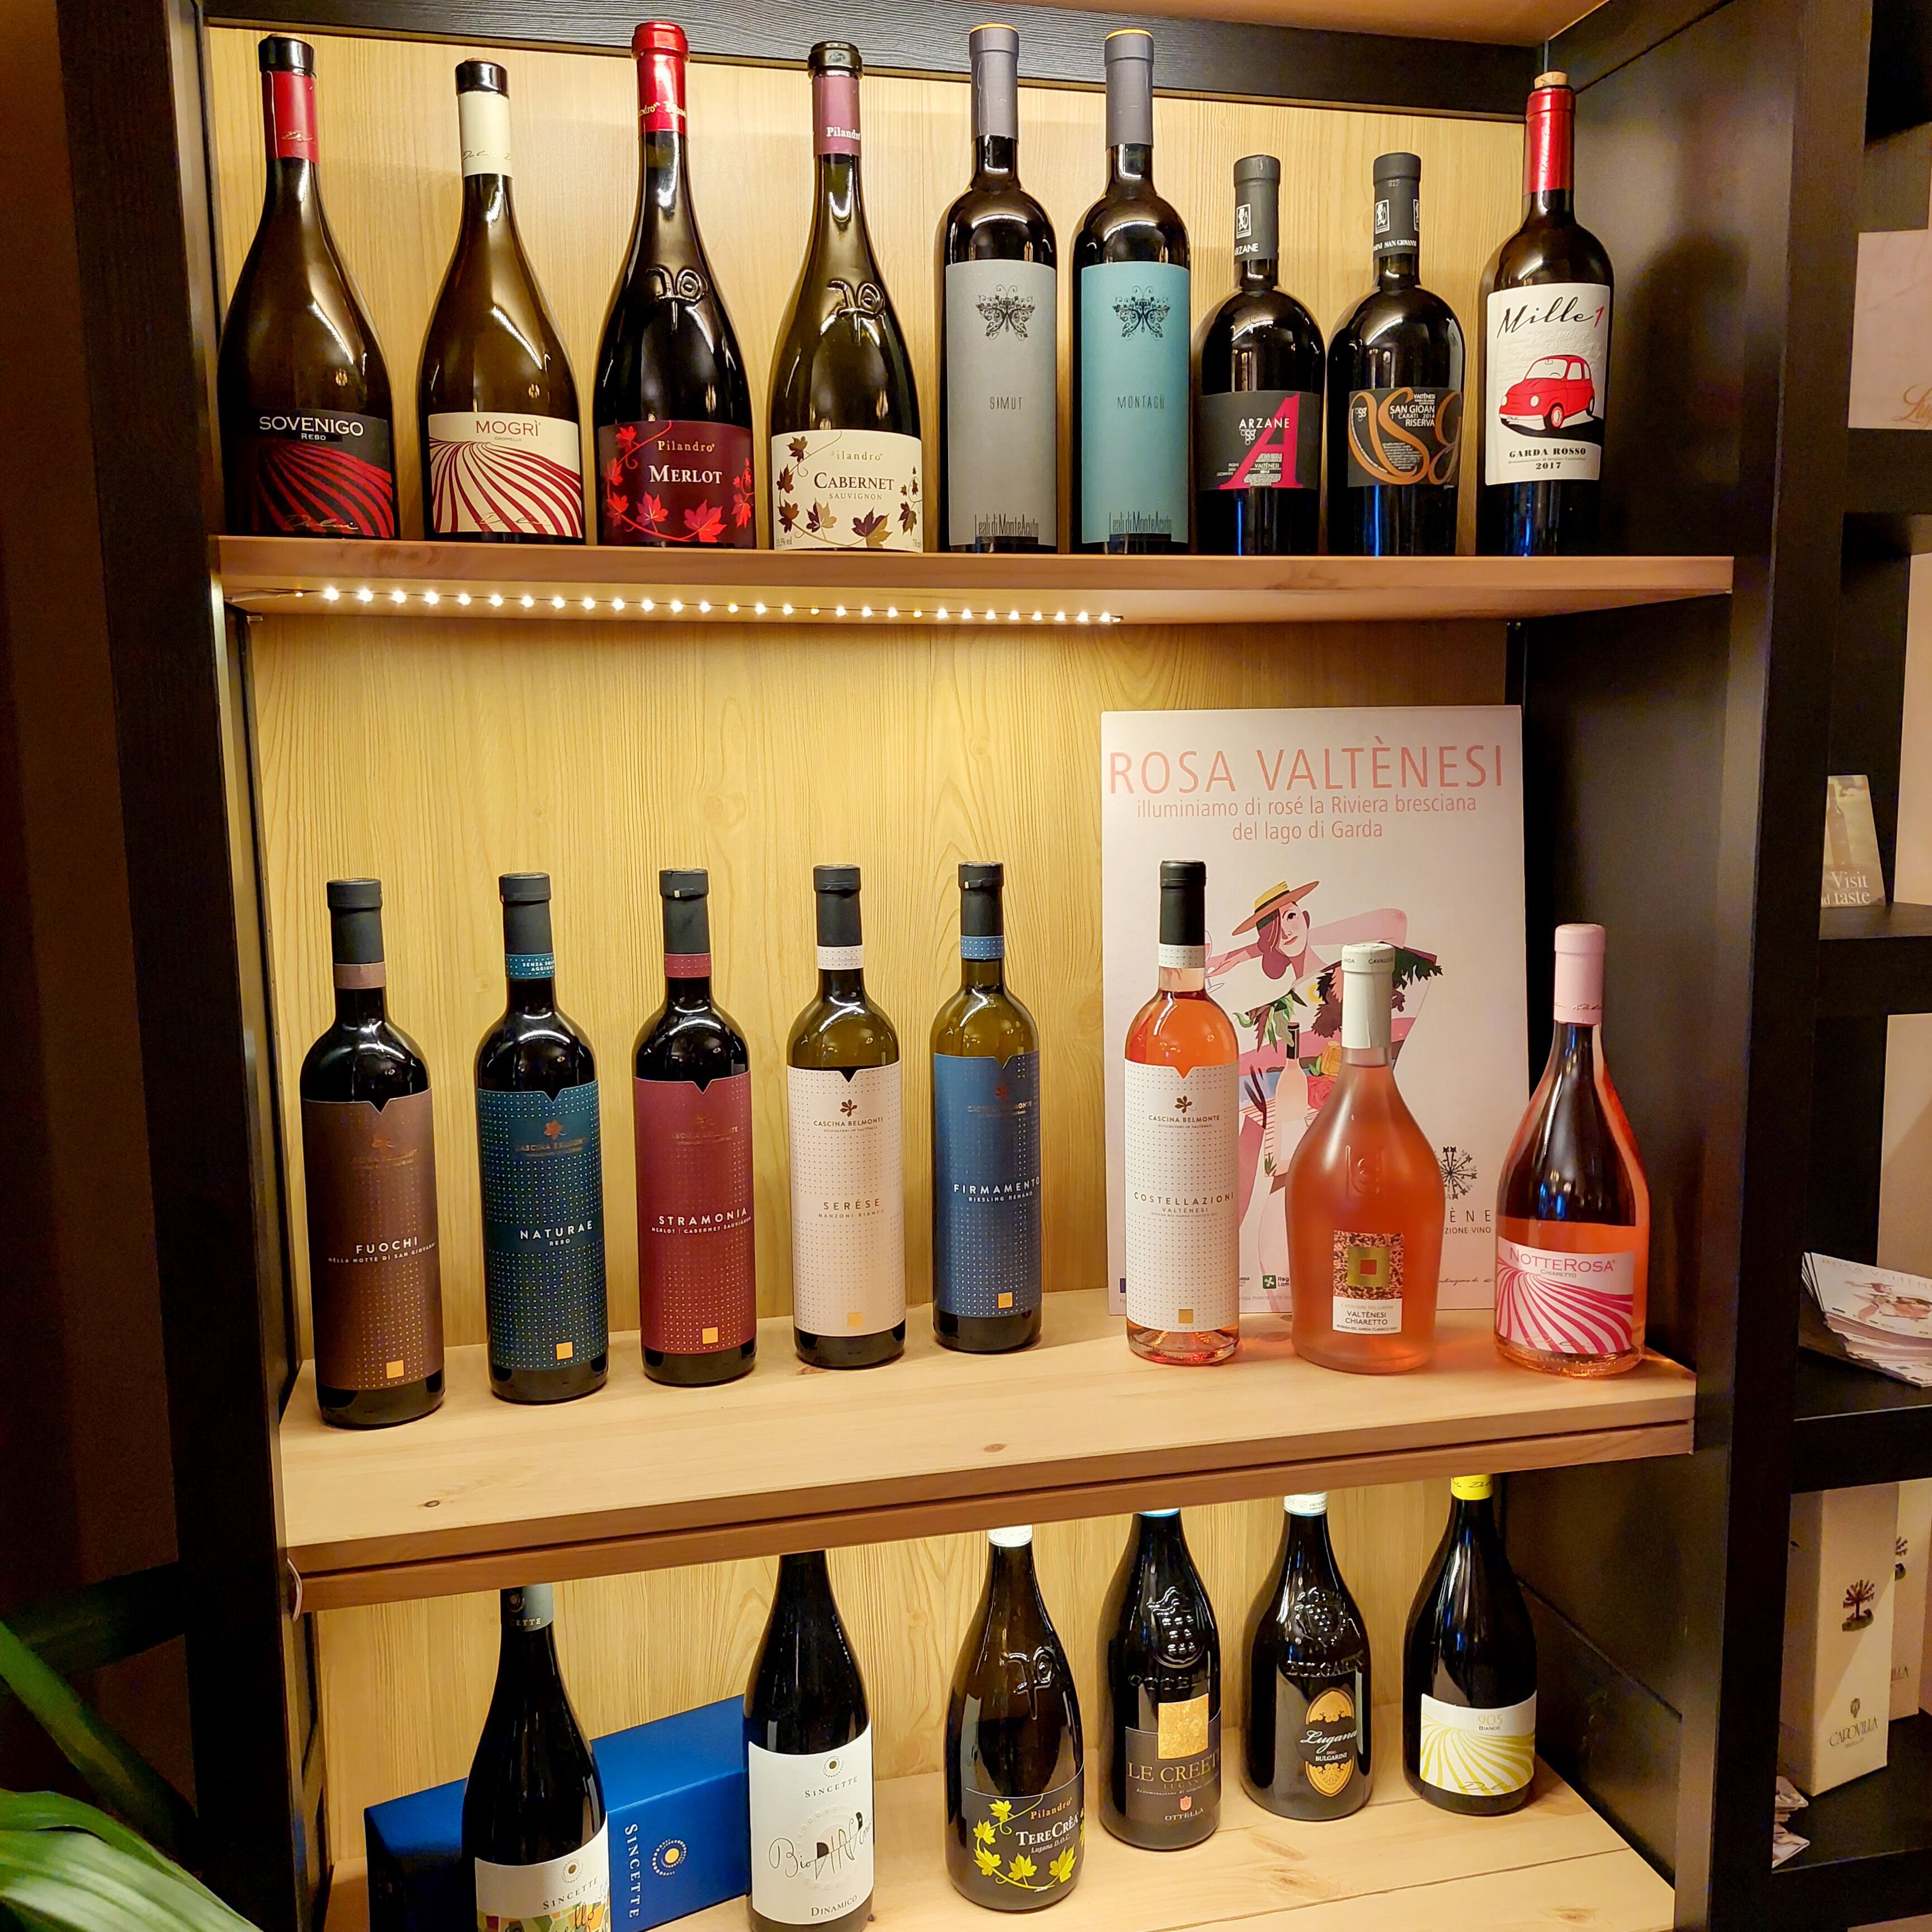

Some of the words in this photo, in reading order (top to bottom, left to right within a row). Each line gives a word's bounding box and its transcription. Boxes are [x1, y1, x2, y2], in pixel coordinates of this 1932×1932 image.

[989, 396, 1022, 410] SIMUT
[1390, 405, 1408, 414] SAN
[1409, 404, 1435, 414] GIOAN
[259, 416, 364, 437] SOVENIGO
[1238, 418, 1290, 429] ARZANE
[1405, 418, 1435, 427] RISERVA
[1509, 448, 1548, 458] GARDA
[1552, 447, 1587, 455] ROSSO
[813, 472, 894, 490] CABERNET
[1110, 750, 1236, 794] ROSA
[1256, 736, 1503, 791] VALTÈNESI
[1137, 798, 1238, 818] illuminiamo
[1246, 797, 1261, 816] di
[1268, 796, 1303, 815] rosé
[1310, 796, 1324, 815] la
[1332, 796, 1389, 814] Riviera
[1396, 794, 1476, 813] bresciana
[1232, 822, 1257, 840] del
[1265, 822, 1301, 845] lago
[1309, 821, 1324, 839] di
[1331, 820, 1383, 838] Garda
[1830, 870, 1869, 889] Visit
[1834, 891, 1871, 905] taste
[1148, 1115, 1180, 1123] CASCINA
[1182, 1114, 1220, 1123] BELMONTE
[954, 1176, 1040, 1195] FIRMAMENTO
[1133, 1191, 1234, 1206] COSTELLAZIONI
[659, 1206, 747, 1226] STRAMONIA
[519, 1220, 593, 1240] NATURAE
[684, 1225, 721, 1234] CABERNET
[356, 1236, 418, 1254] FUOCHI
[549, 1238, 571, 1247] REBO
[1478, 1713, 1503, 1726] 905
[1300, 1730, 1358, 1754] Lugana
[1315, 1751, 1347, 1761] BULGARINI
[1128, 1762, 1154, 1783] LE
[1160, 1749, 1220, 1783] CREET
[804, 1776, 858, 1798] SINCETTE
[1030, 1799, 1071, 1820] Pilandro
[1164, 1807, 1204, 1821] OTTELLA
[1031, 1844, 1053, 1854] Lugana
[624, 1824, 641, 1918] SINCETTE
[542, 1877, 599, 1910] SINCETTE
[811, 1895, 858, 1917] DINAMICO
